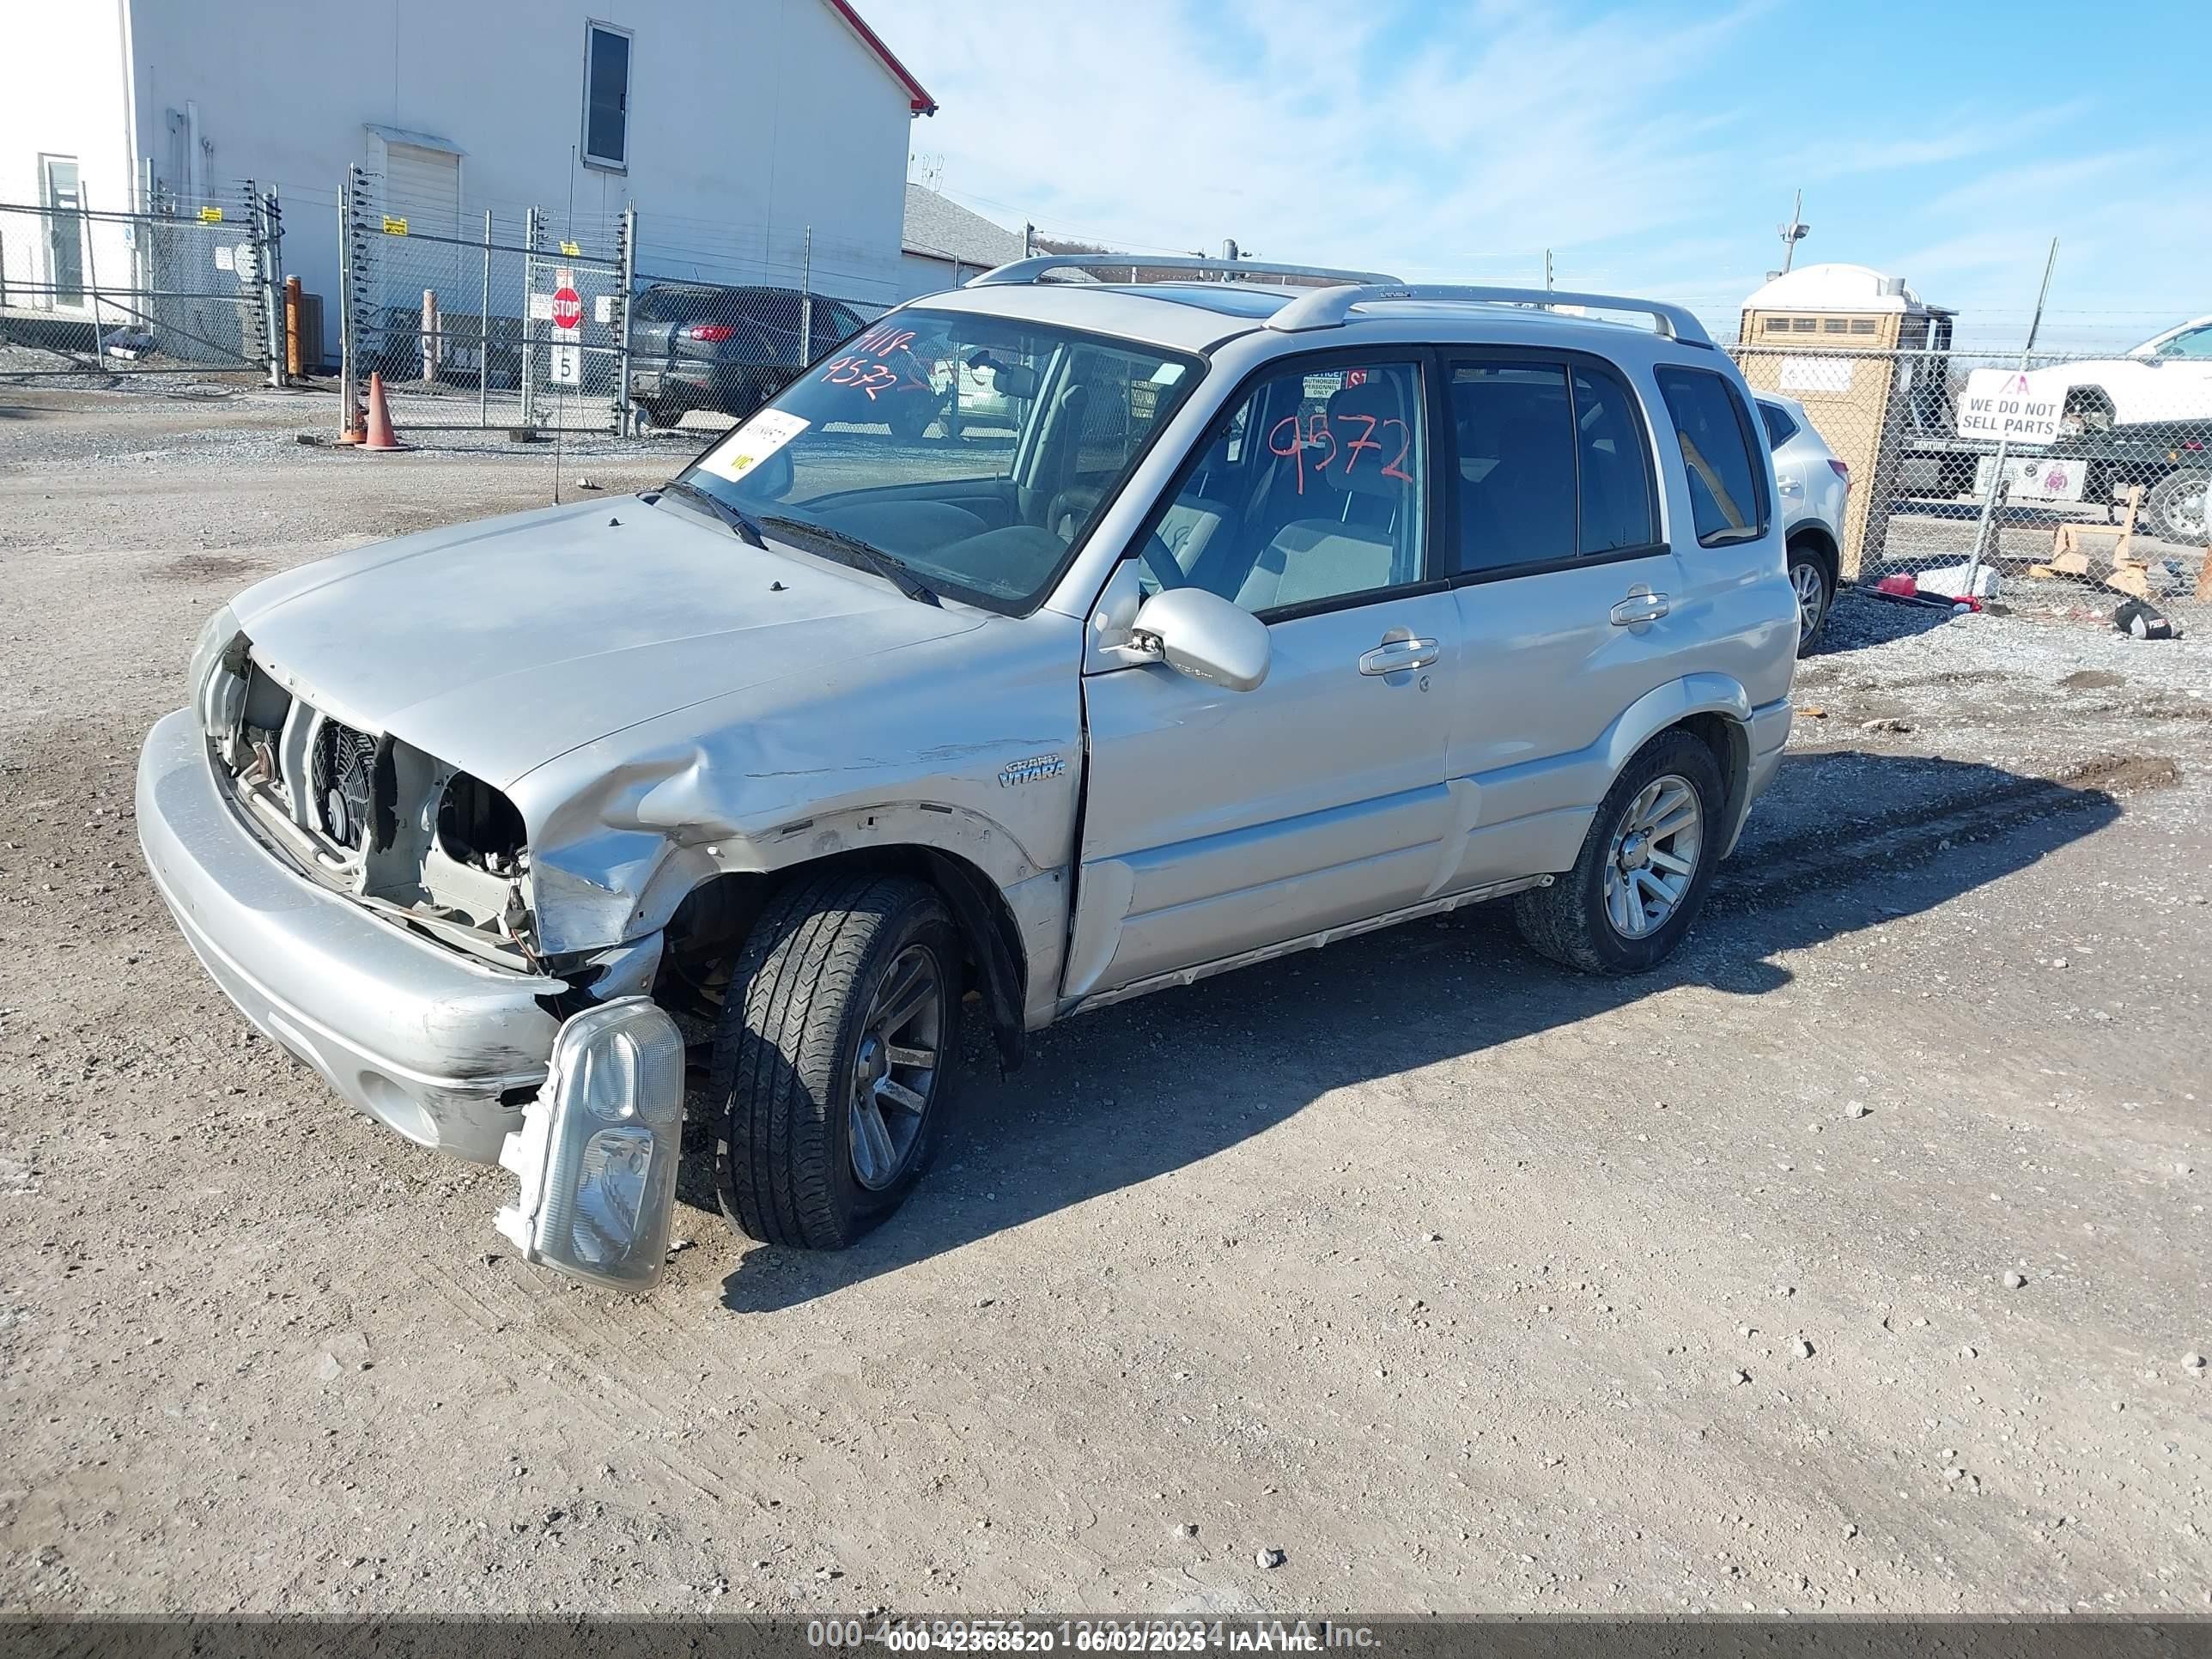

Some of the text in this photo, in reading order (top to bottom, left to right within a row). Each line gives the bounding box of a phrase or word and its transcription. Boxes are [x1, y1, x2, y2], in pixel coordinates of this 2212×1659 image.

[553, 301, 580, 318] STOP
[555, 333, 578, 343] SPEED
[561, 357, 571, 378] 5
[1971, 398, 2057, 417] WE DO NOT
[1962, 415, 2055, 435] SELL PARTS
[1268, 414, 1414, 495] 9572
[1005, 753, 1059, 773] GRAND
[998, 760, 1066, 787] VITARA
